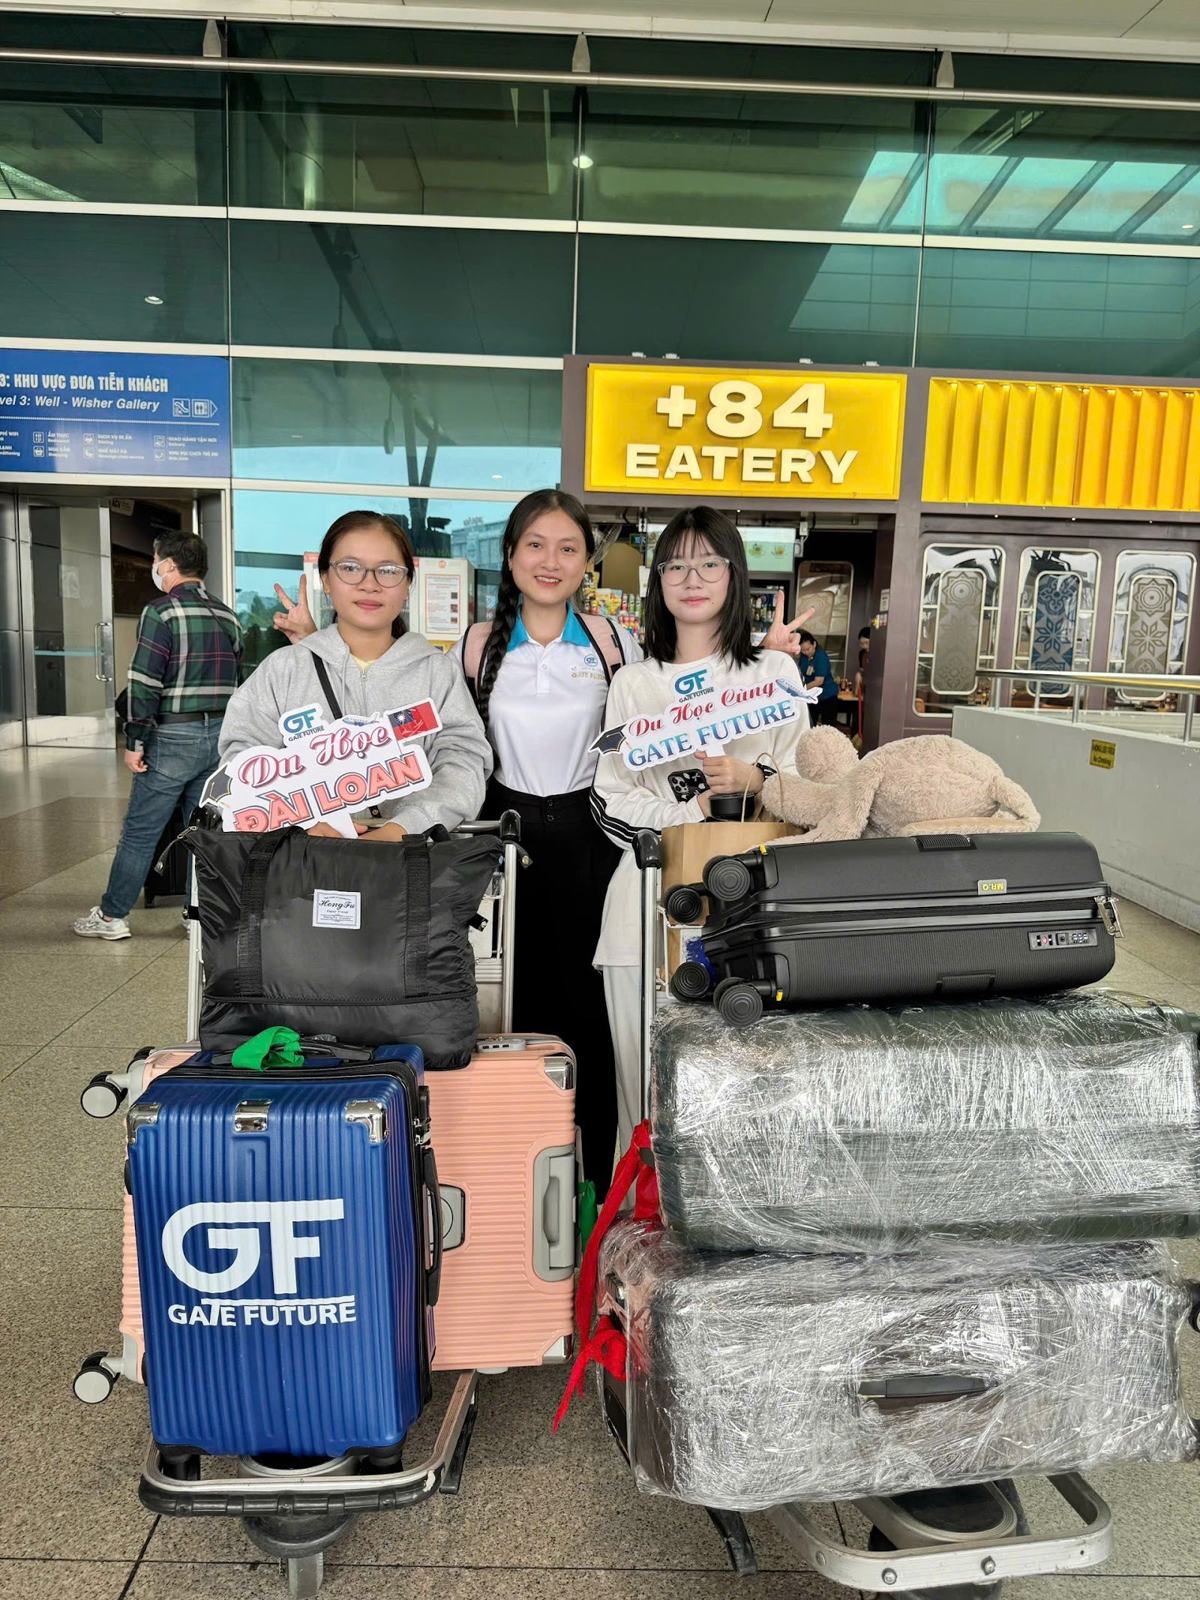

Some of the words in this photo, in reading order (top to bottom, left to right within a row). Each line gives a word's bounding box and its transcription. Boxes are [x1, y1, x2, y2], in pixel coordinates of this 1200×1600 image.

[0, 373, 10, 387] 3:
[14, 373, 39, 388] KHU
[42, 374, 66, 391] VỰC
[70, 374, 95, 390] ĐƯA
[98, 372, 124, 391] TIỄN
[128, 375, 169, 392] KHÁCH
[20, 396, 31, 406] 3:
[35, 396, 60, 407] Well
[72, 397, 113, 409] Wisher
[116, 399, 160, 412] Gallery
[656, 380, 834, 439] +84
[625, 443, 859, 485] EATERY
[675, 669, 708, 695] GF
[283, 708, 317, 734] GF
[628, 717, 664, 737] Du
[670, 702, 716, 724] Học
[720, 680, 776, 707] Cùng
[238, 754, 306, 789] Du
[310, 726, 392, 765] Học
[627, 733, 693, 767] GATE
[697, 700, 796, 747] FUTURE
[232, 789, 313, 832] ĐÀI
[311, 751, 425, 815] LOAN
[161, 1198, 345, 1295] GF
[168, 1299, 237, 1326] GATE
[244, 1301, 357, 1326] FUTURE
